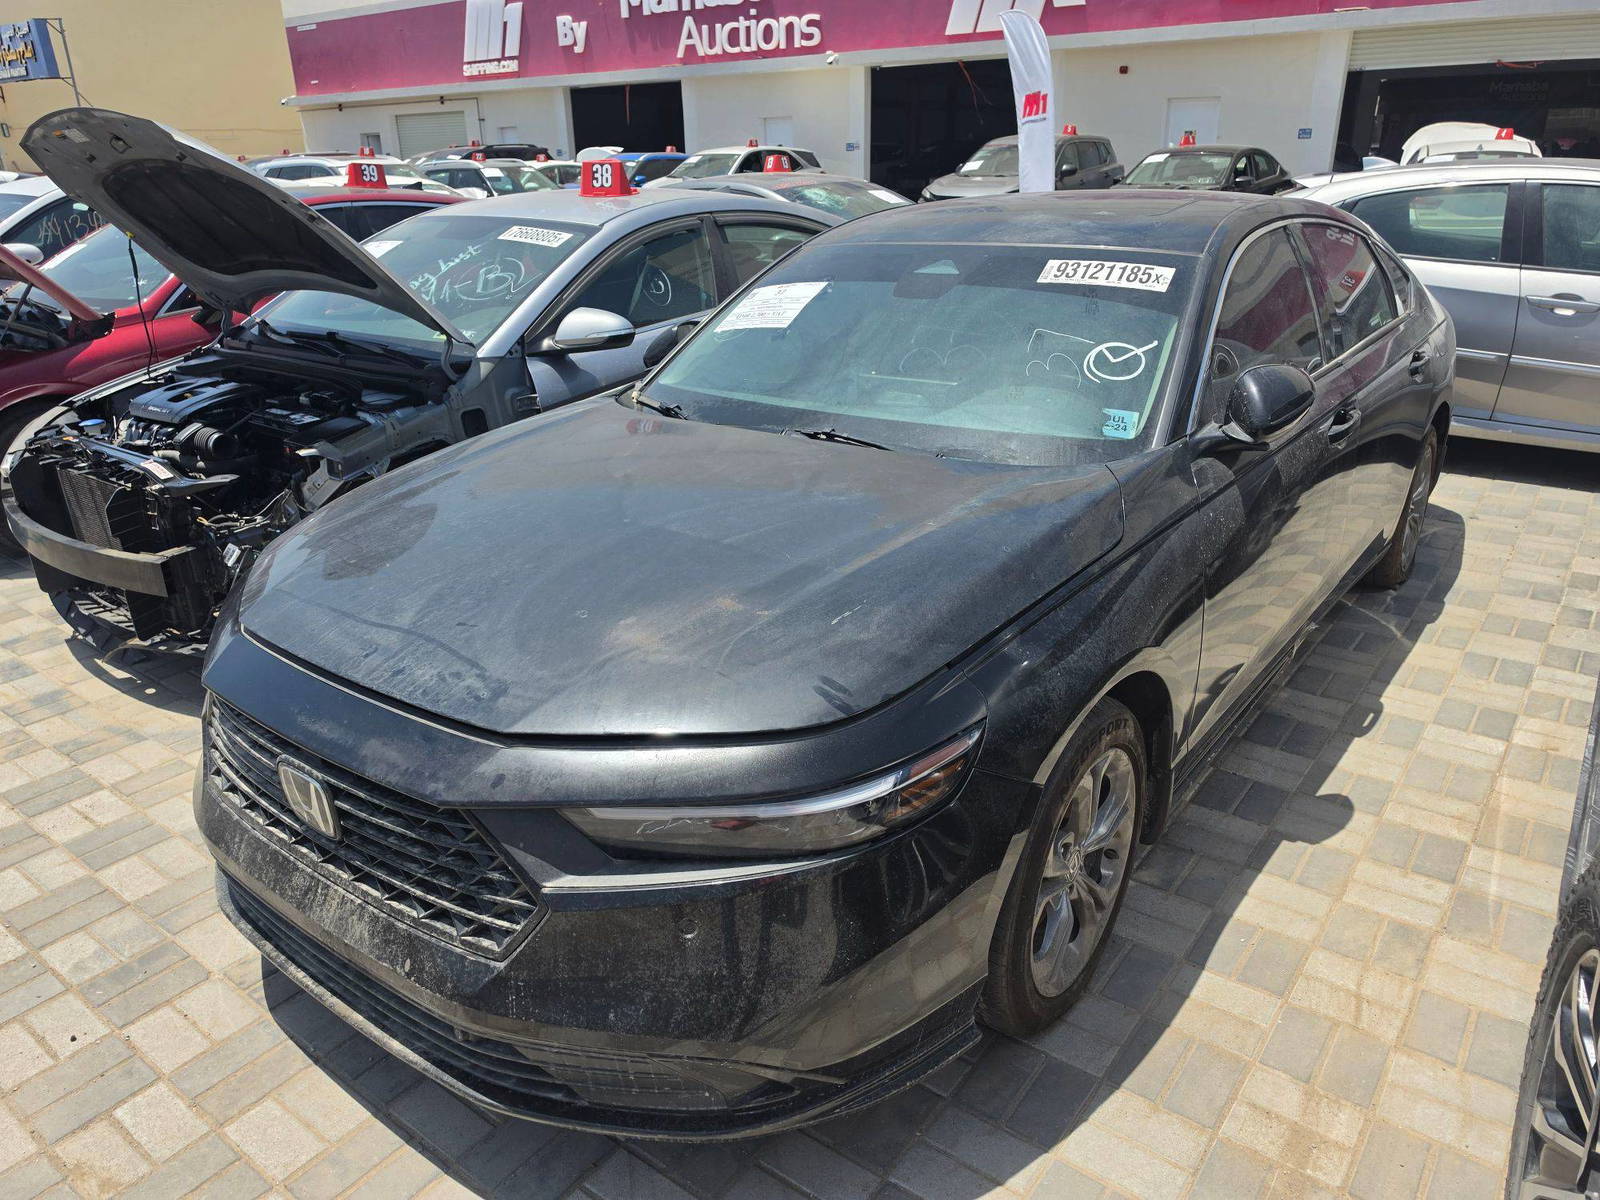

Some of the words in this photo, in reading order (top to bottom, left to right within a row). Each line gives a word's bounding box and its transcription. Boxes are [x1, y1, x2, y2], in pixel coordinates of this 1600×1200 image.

[556, 15, 588, 53] By
[677, 9, 821, 58] Auctions
[361, 163, 378, 182] 39
[592, 163, 612, 188] 38
